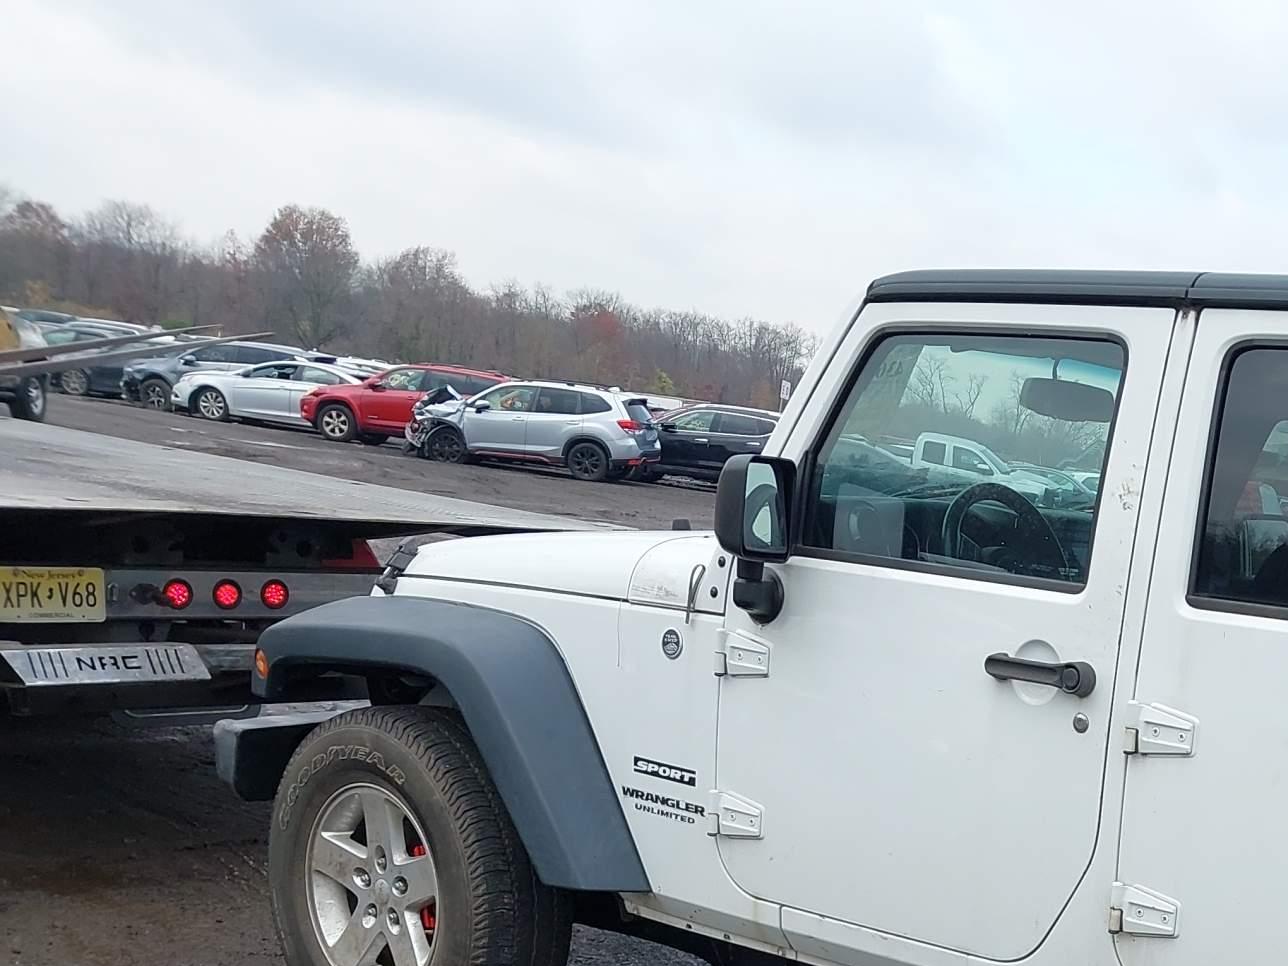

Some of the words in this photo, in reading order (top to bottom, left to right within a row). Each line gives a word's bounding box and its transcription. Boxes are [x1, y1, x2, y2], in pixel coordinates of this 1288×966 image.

[21, 570, 45, 579] New
[46, 570, 76, 581] Jersey
[635, 760, 696, 784] SPORT
[621, 785, 706, 818] WRANGLER
[634, 803, 696, 825] UNLIMITED
